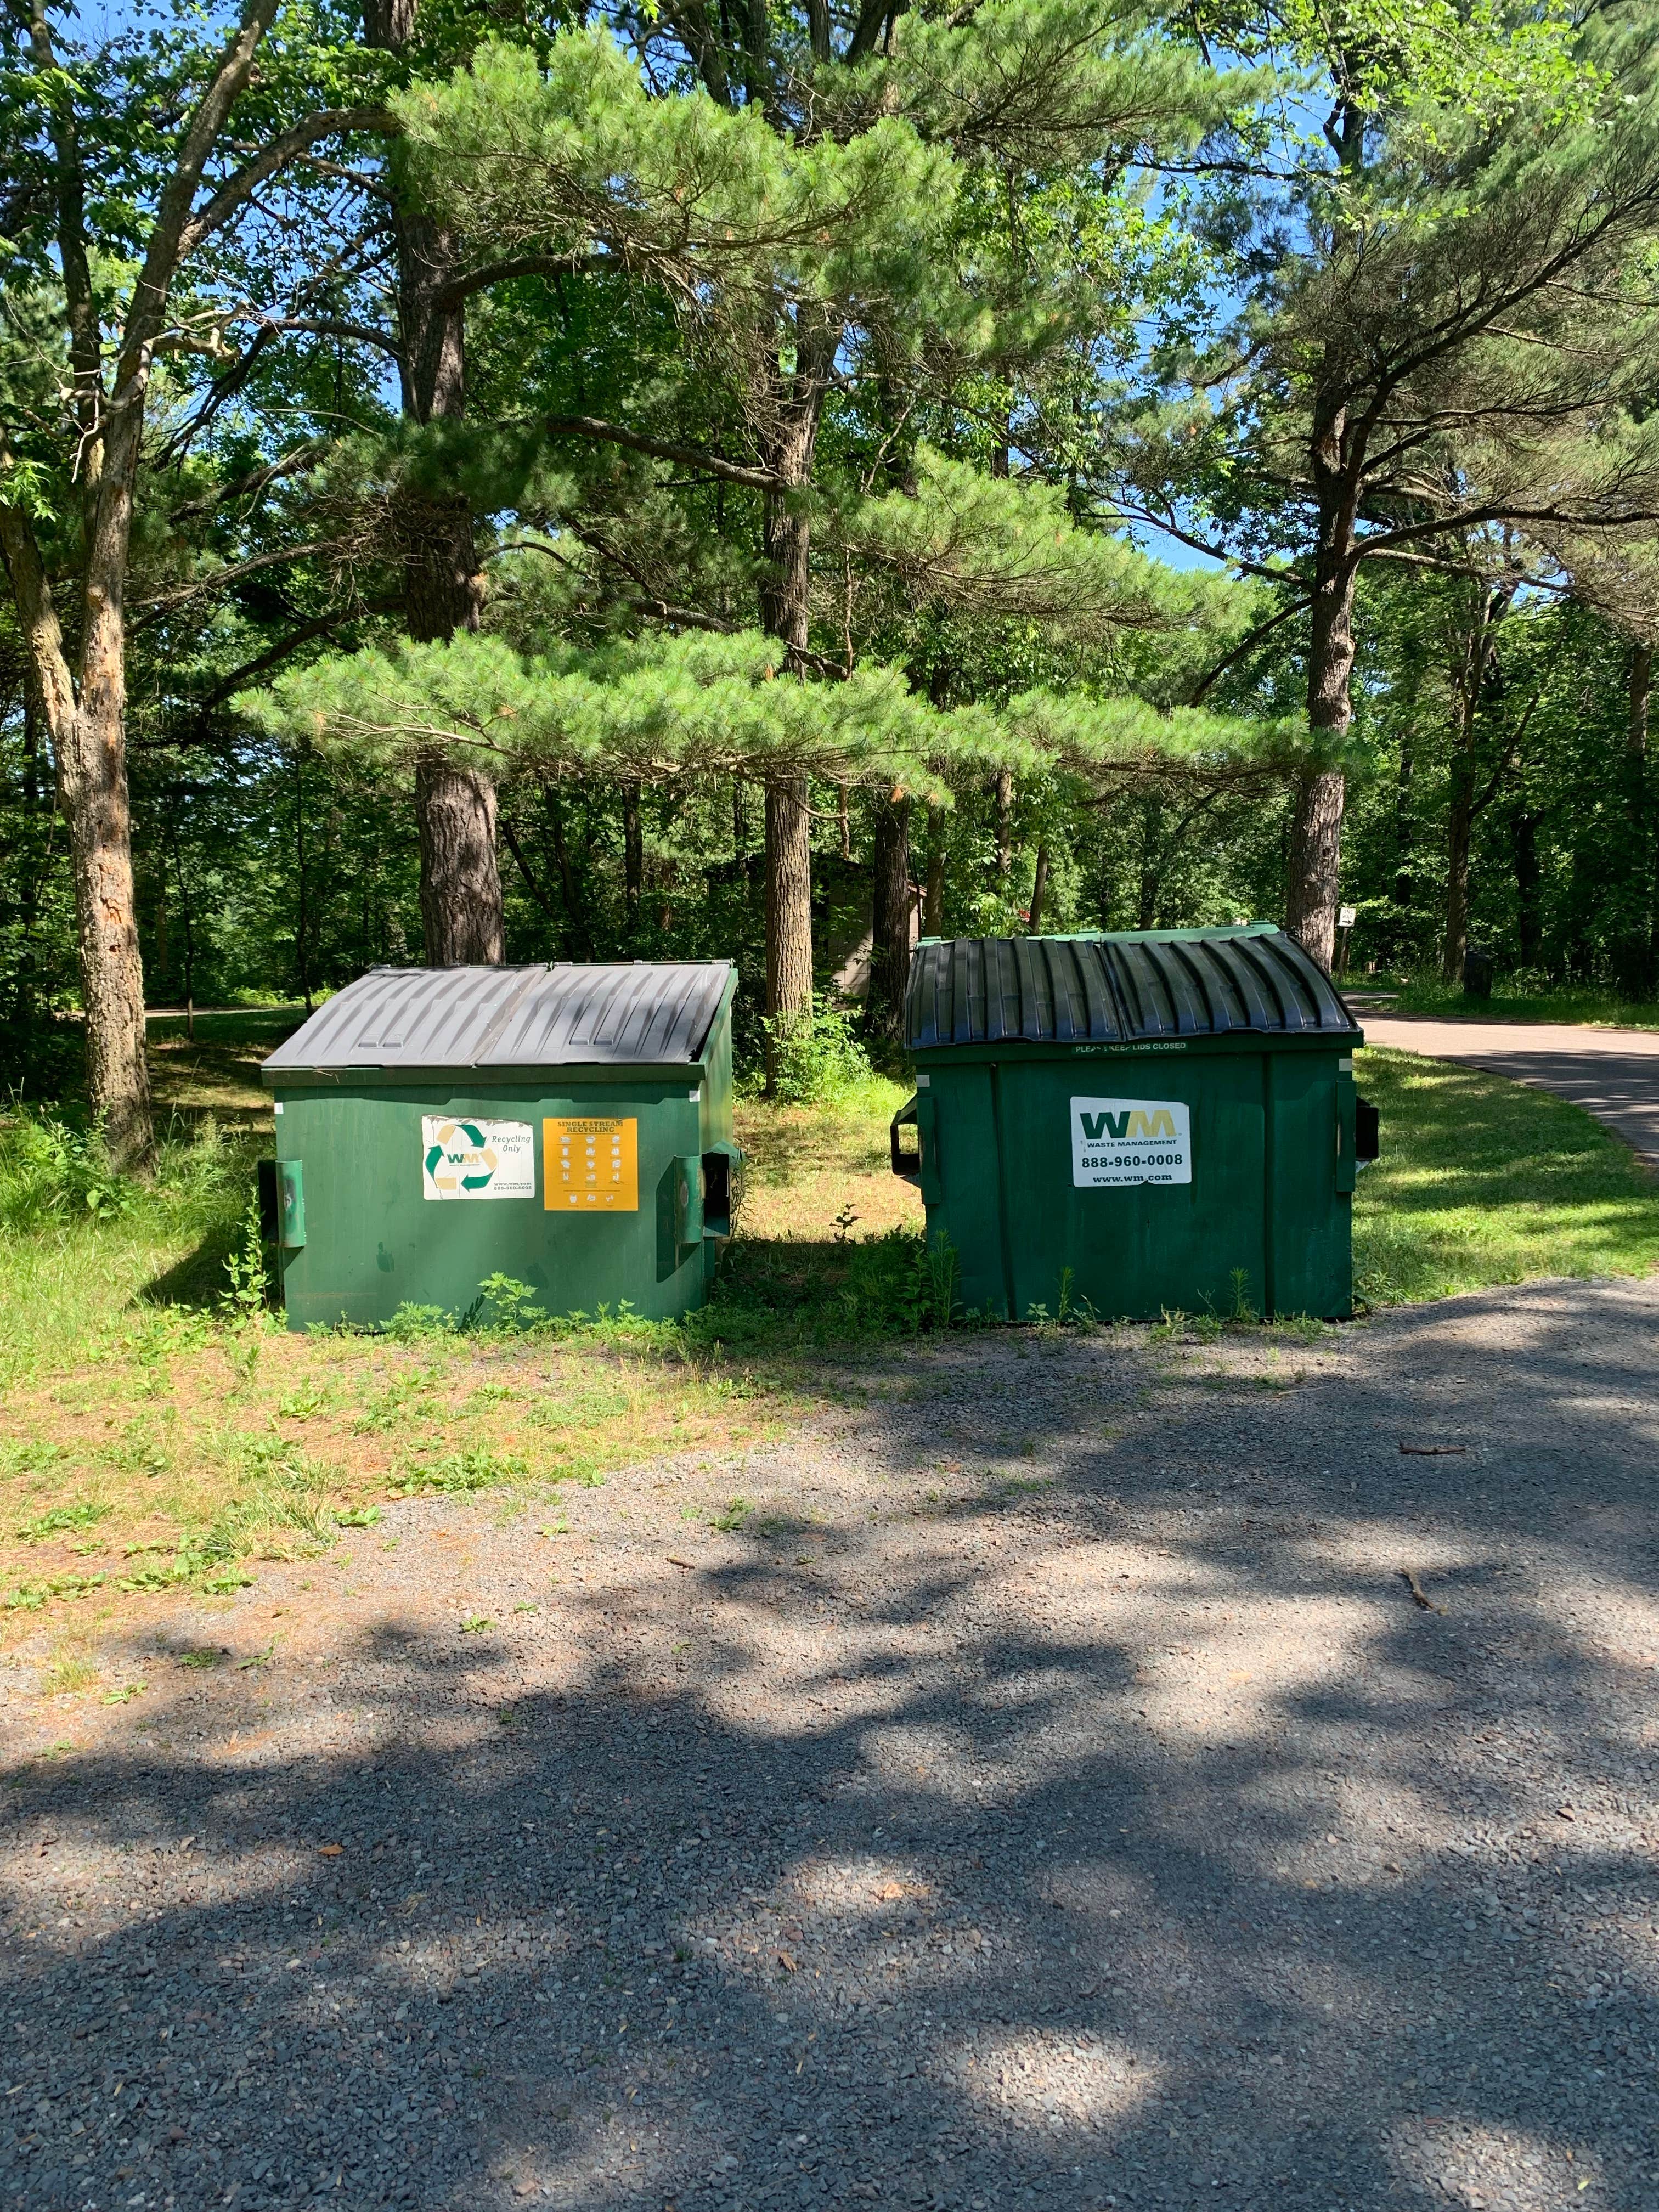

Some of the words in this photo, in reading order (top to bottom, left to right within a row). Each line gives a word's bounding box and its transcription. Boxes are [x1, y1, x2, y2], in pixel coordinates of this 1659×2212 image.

[1080, 1110, 1177, 1139] WM
[492, 1135, 531, 1144] Recycling
[503, 1144, 521, 1153] Only
[447, 1154, 479, 1163] WM
[1082, 1154, 1182, 1167] 888-960-0008
